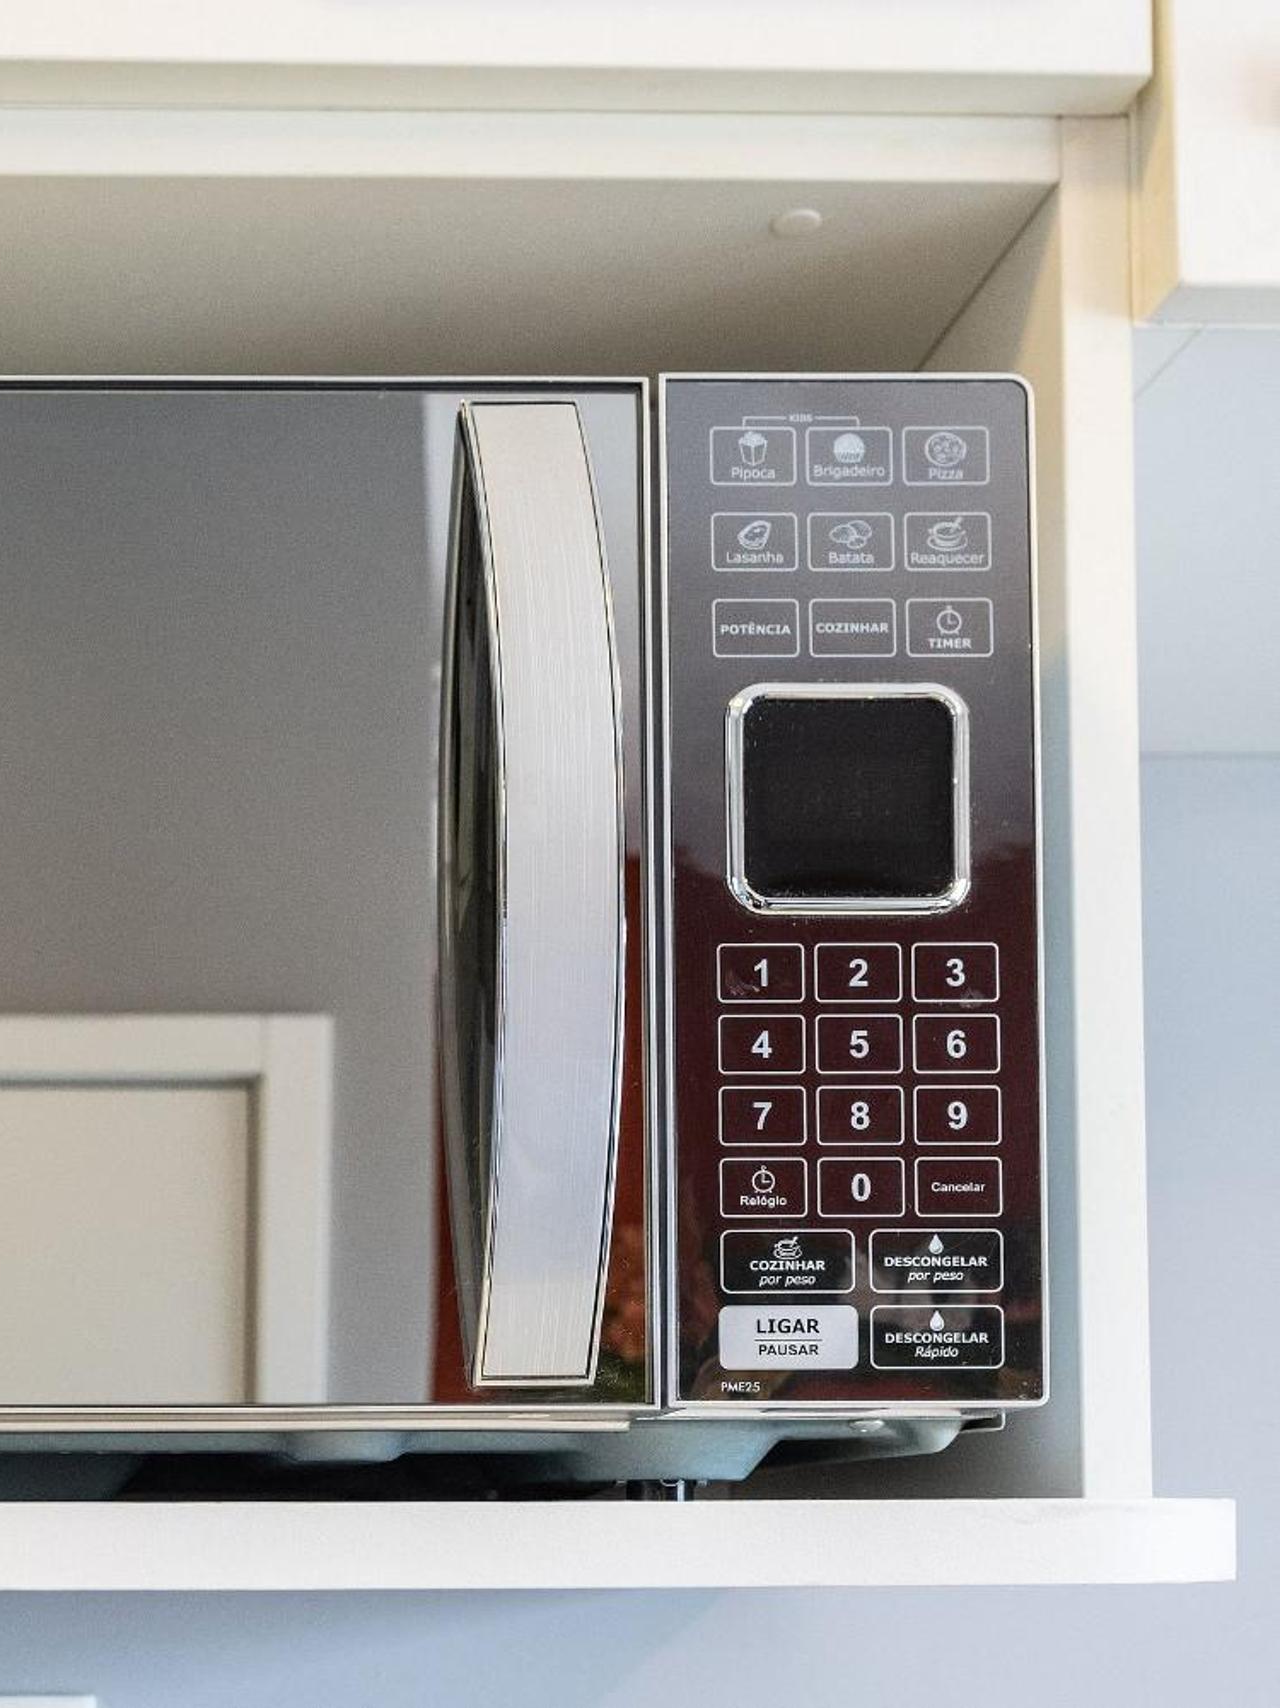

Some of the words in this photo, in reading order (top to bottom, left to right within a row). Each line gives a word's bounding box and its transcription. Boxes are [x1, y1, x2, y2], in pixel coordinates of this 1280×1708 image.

[730, 466, 776, 481] Pipoca
[813, 464, 886, 480] Brigadeiro
[927, 467, 964, 480] Pizza
[726, 551, 784, 564] Lasanha
[828, 552, 875, 565] Batata
[910, 552, 984, 568] Reaquecer
[720, 620, 791, 636] POTÊNCIA
[815, 621, 889, 634] COZINHAR
[927, 637, 972, 649] TIMER
[753, 958, 769, 988] 1
[848, 958, 869, 988] 2
[945, 958, 966, 988] 3
[750, 1030, 773, 1059] 4
[849, 1030, 870, 1059] 5
[945, 1029, 967, 1059] 6
[752, 1101, 773, 1130] 7
[849, 1101, 871, 1130] 8
[946, 1100, 968, 1130] 9
[850, 1172, 872, 1202] 0
[930, 1181, 986, 1193] Cancelar
[739, 1194, 787, 1208] Relógio
[749, 1260, 826, 1271] COZINHAR
[884, 1256, 988, 1268] DESCONGELAR
[759, 1275, 782, 1287] por
[784, 1275, 817, 1287] peso
[907, 1271, 930, 1283] por
[933, 1271, 964, 1283] peso
[755, 1317, 821, 1334] LIGAR
[885, 1332, 989, 1344] DESCONGELAR
[758, 1343, 819, 1356] PAUSAR
[914, 1345, 959, 1360] Rápido
[720, 1381, 761, 1393] PME25
